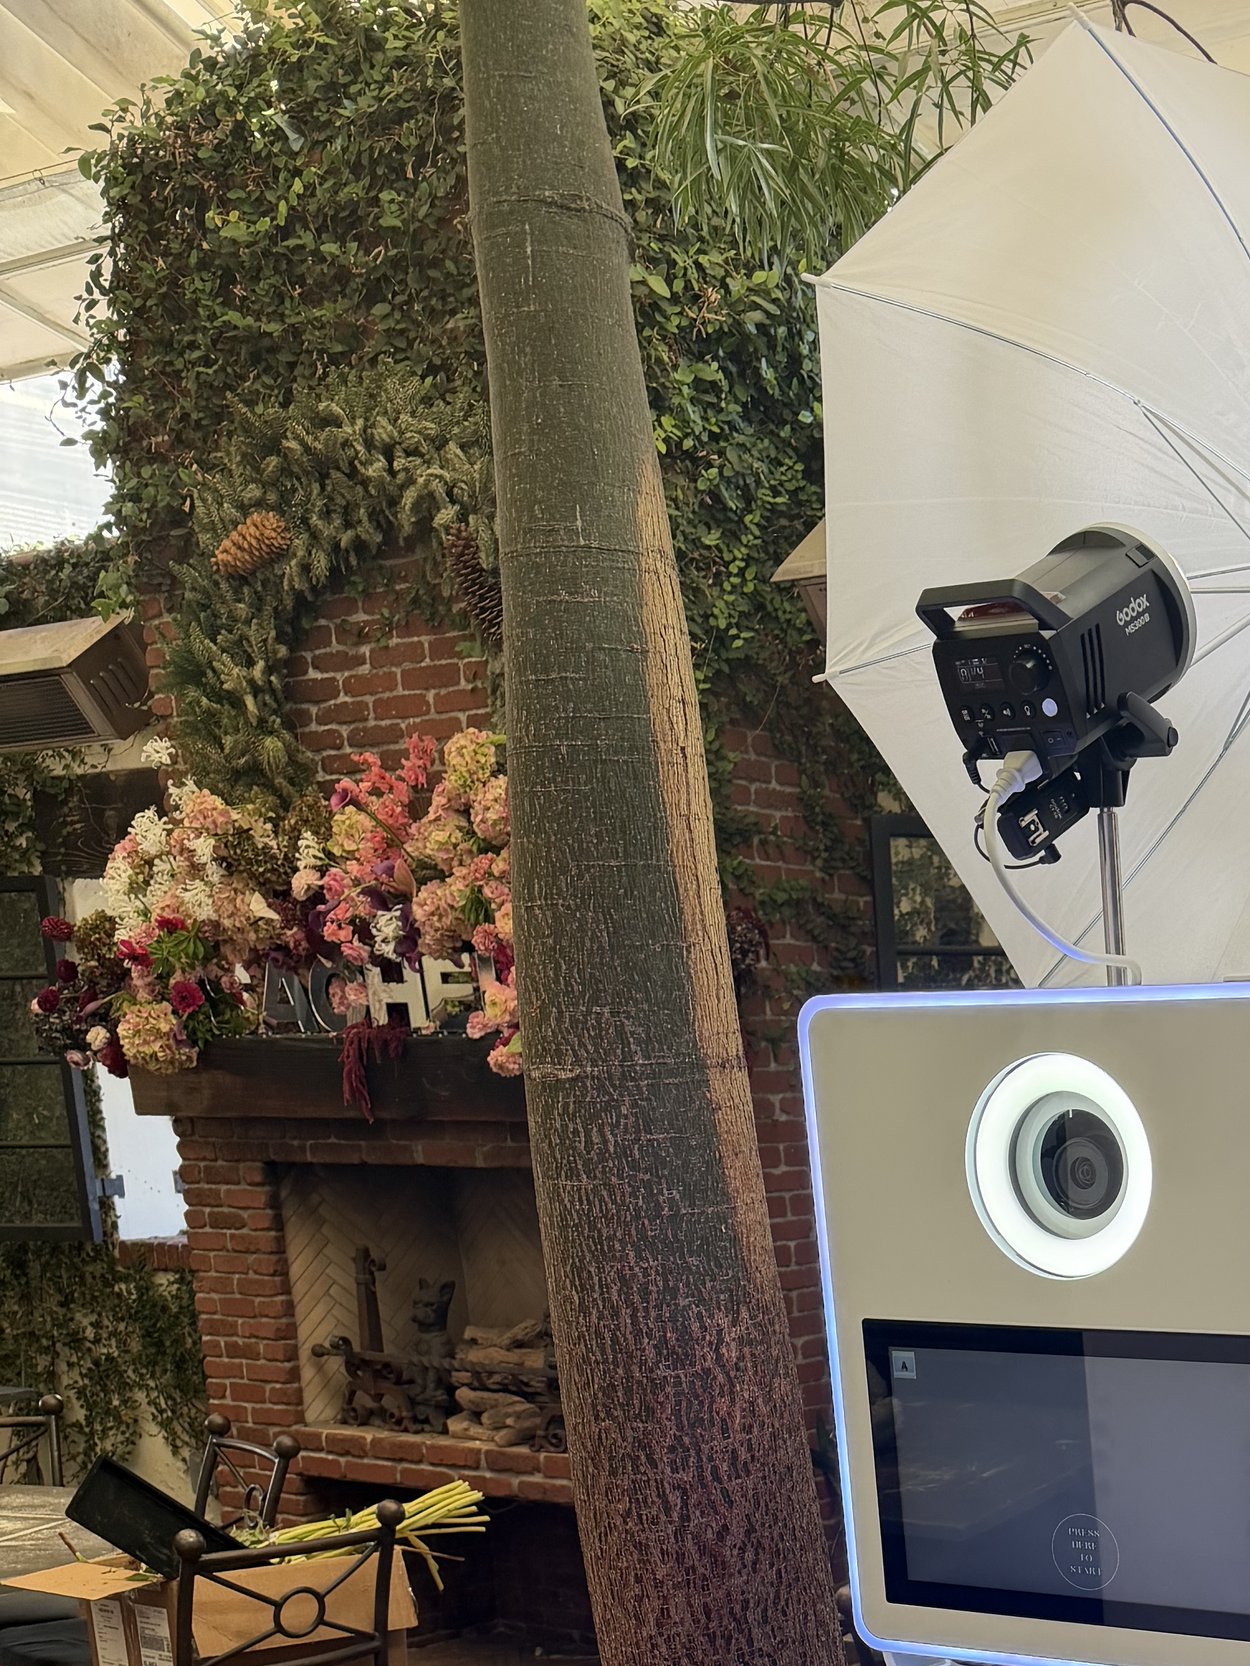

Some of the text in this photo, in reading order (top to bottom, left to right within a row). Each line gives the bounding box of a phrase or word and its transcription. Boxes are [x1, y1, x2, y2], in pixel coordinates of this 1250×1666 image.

[1116, 593, 1150, 626] Godox
[1068, 1527, 1100, 1537] PRESS
[1071, 1541, 1097, 1550] HERE
[1080, 1553, 1093, 1562] TO
[1070, 1565, 1102, 1576] START
